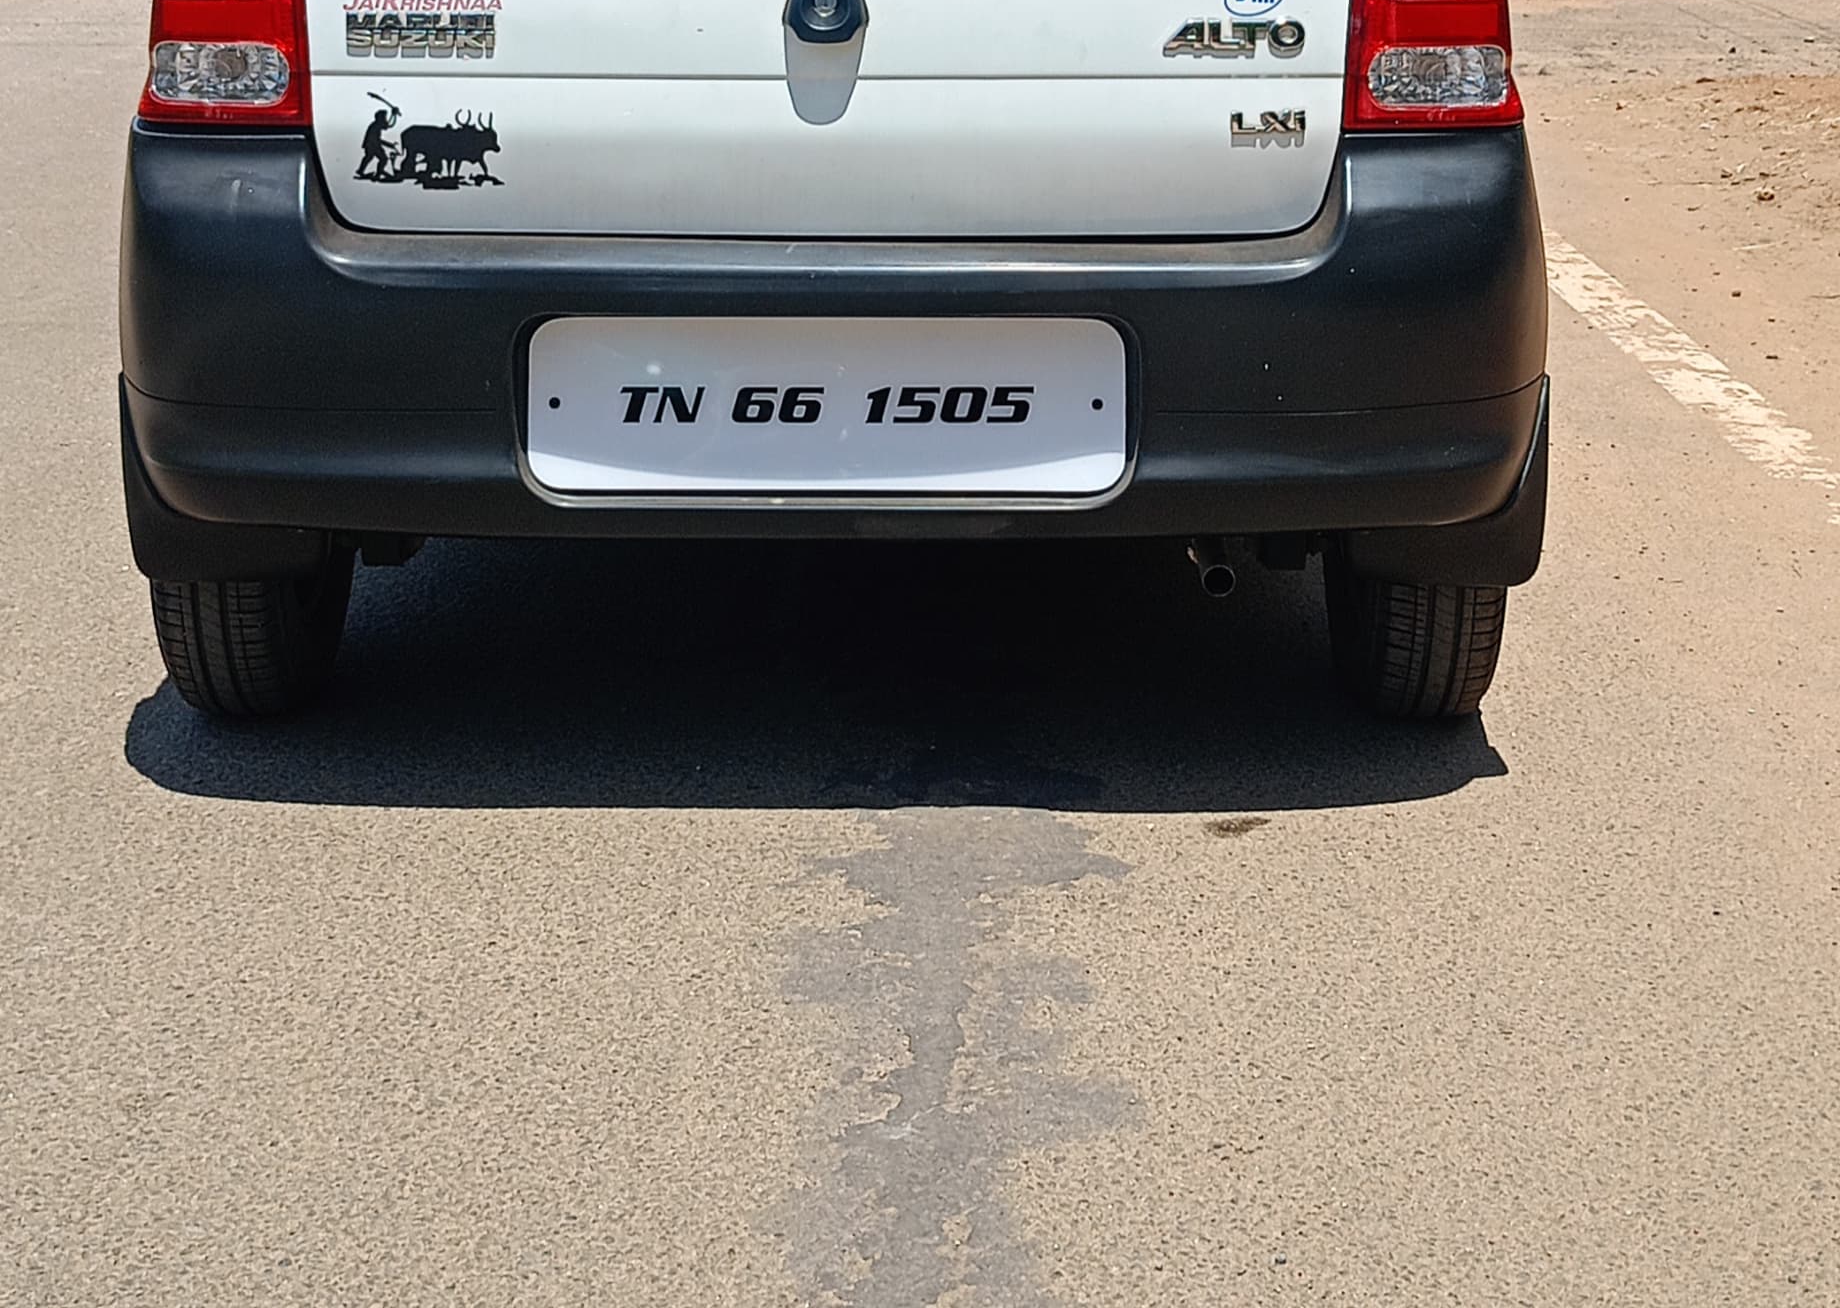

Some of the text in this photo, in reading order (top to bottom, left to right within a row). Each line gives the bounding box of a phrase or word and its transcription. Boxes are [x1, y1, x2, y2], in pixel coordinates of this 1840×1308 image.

[346, 28, 496, 56] SUZUKI
[1163, 18, 1305, 57] ALTO
[620, 386, 1035, 424] TN 66 1505
